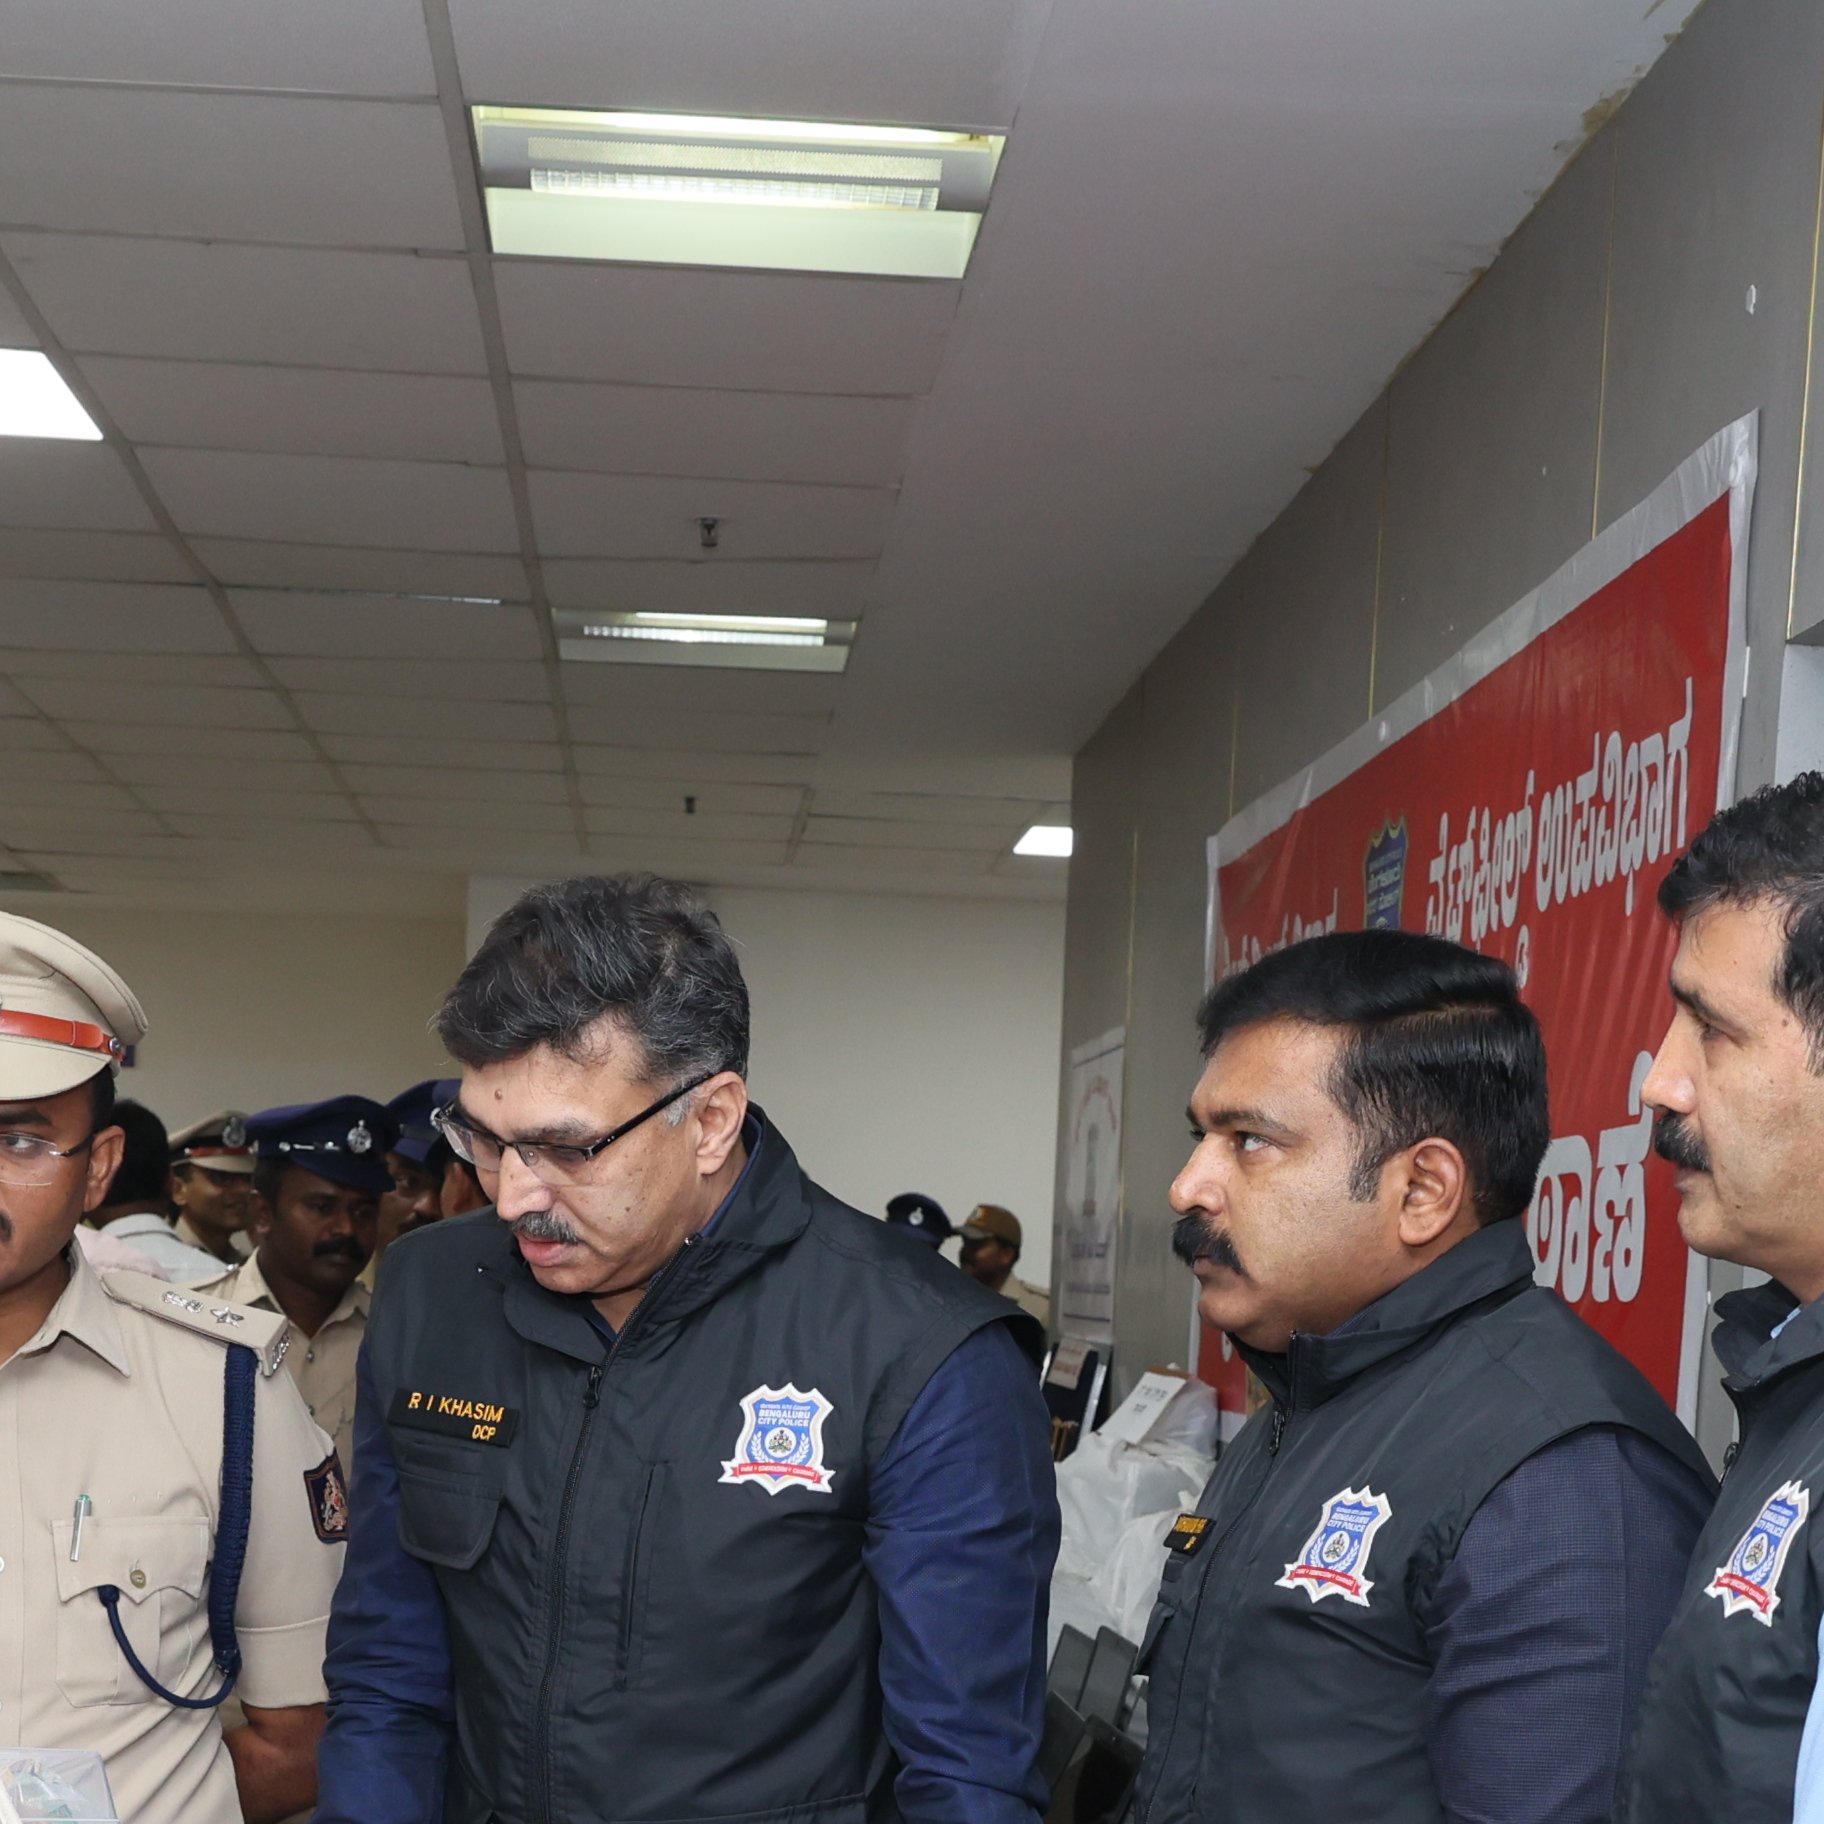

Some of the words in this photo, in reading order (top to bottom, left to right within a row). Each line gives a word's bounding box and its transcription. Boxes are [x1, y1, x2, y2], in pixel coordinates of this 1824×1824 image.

[408, 1392, 423, 1409] R
[426, 1394, 435, 1412] I
[438, 1396, 506, 1424] KHASIM
[758, 1409, 811, 1420] BENGALURU
[757, 1418, 777, 1426] CITY
[778, 1418, 810, 1428] POLICE
[471, 1424, 497, 1441] DCP
[1342, 1520, 1367, 1533] POLICE
